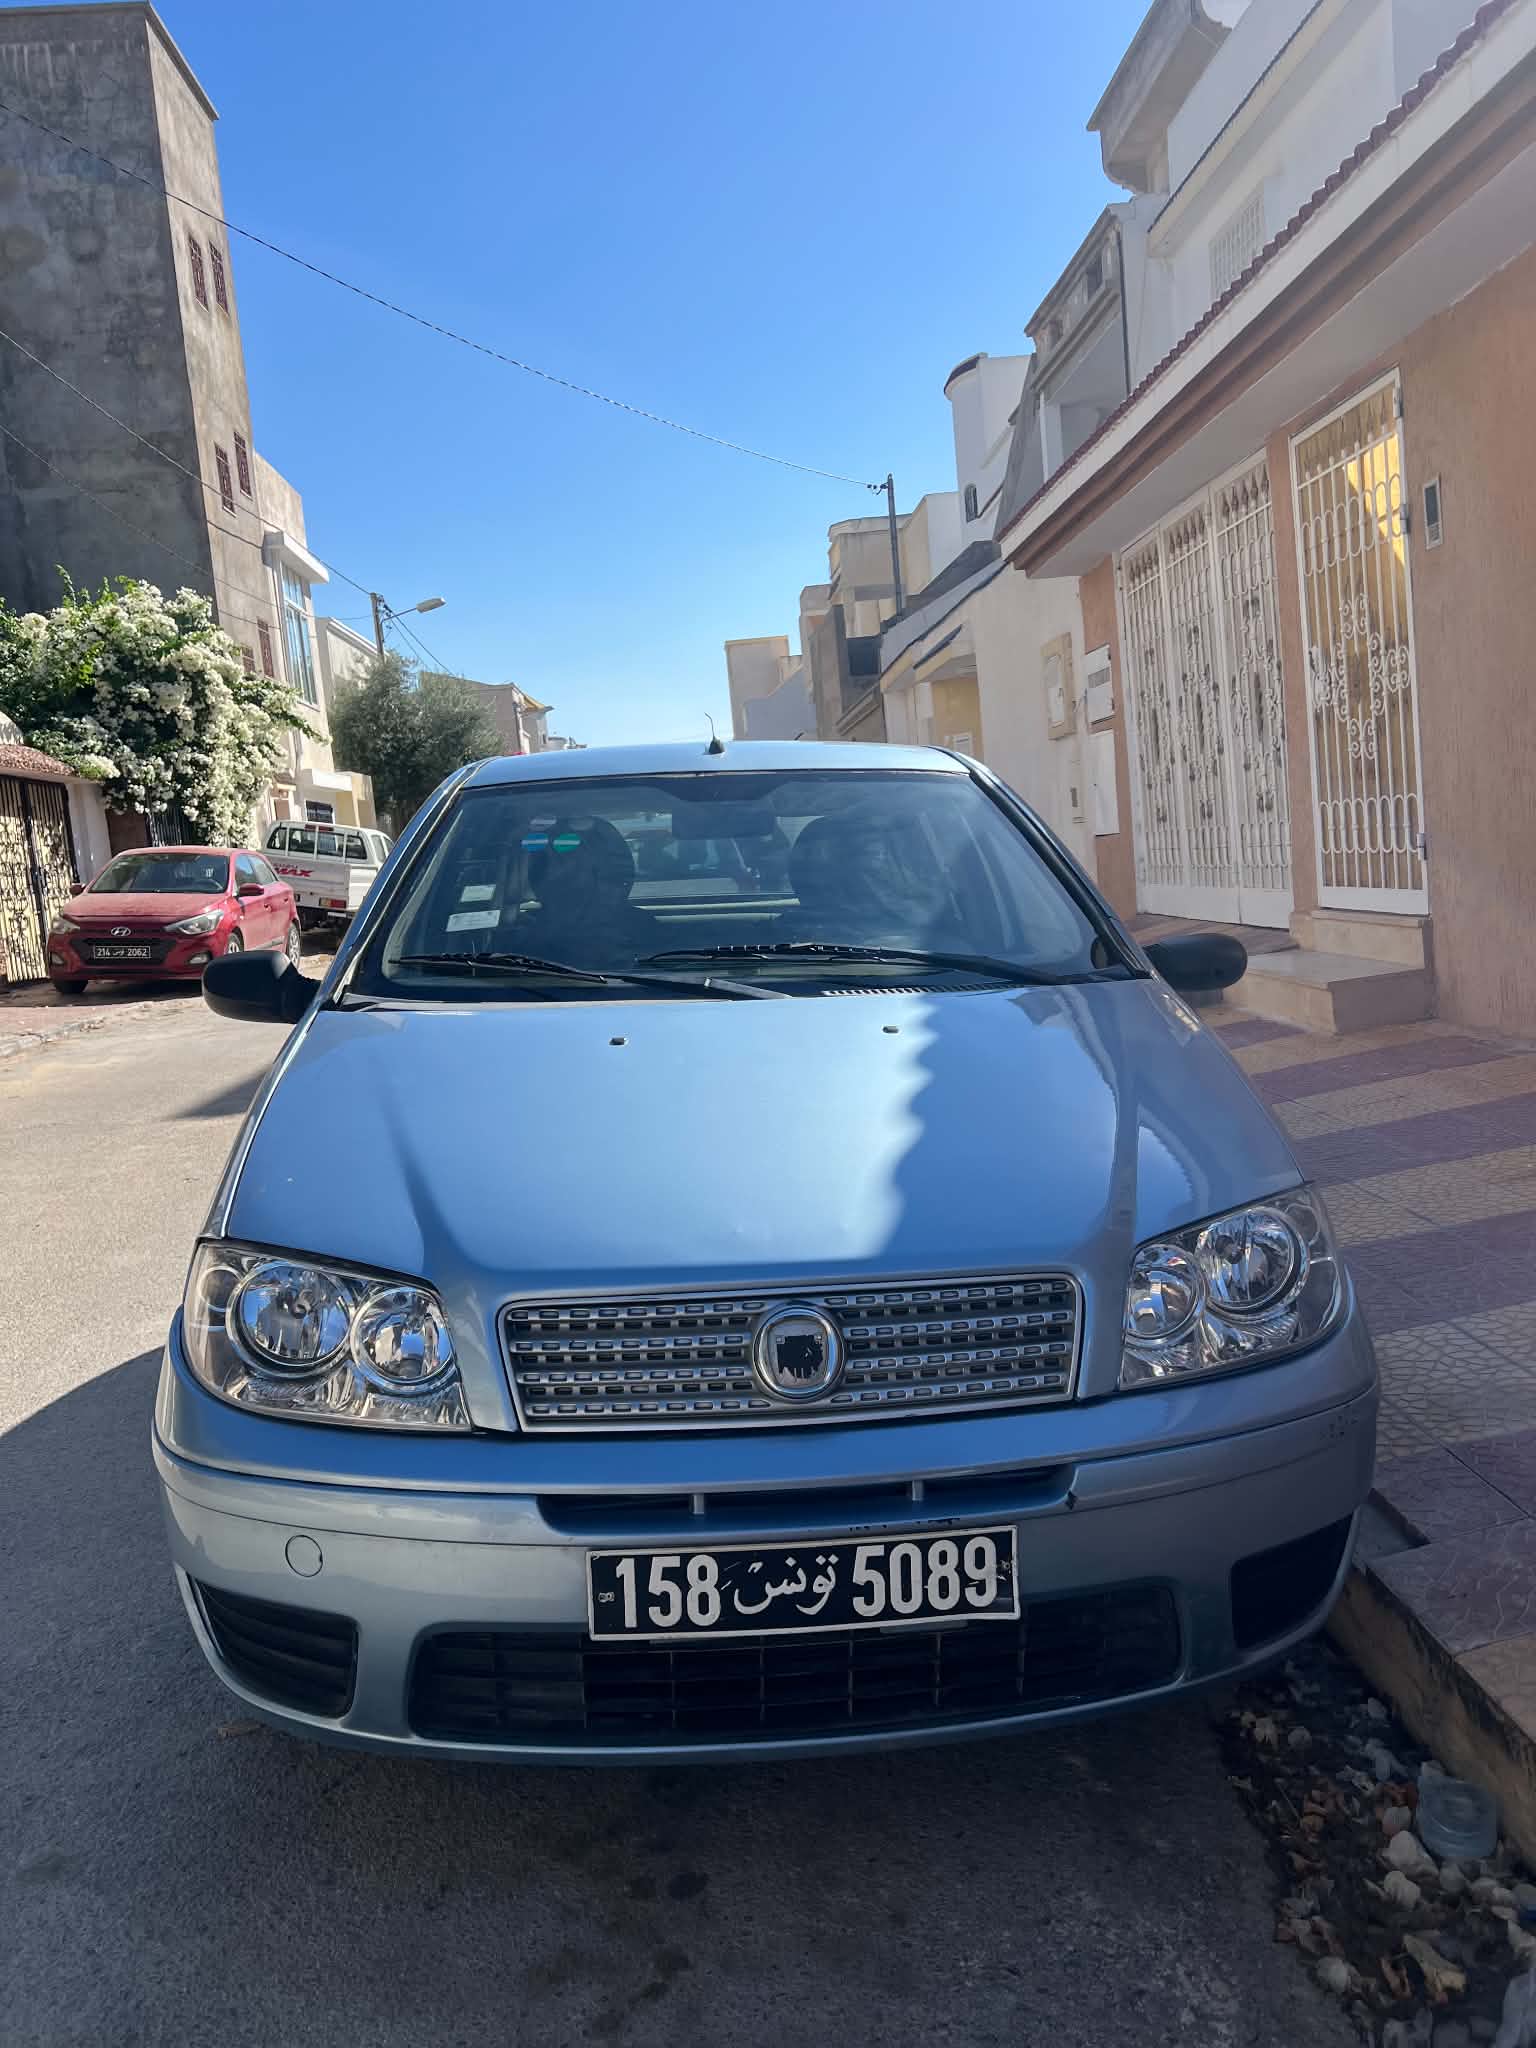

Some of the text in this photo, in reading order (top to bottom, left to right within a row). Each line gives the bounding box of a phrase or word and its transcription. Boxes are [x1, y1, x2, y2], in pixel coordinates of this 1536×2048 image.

[615, 1536, 998, 1628] 158 تونس 5089
